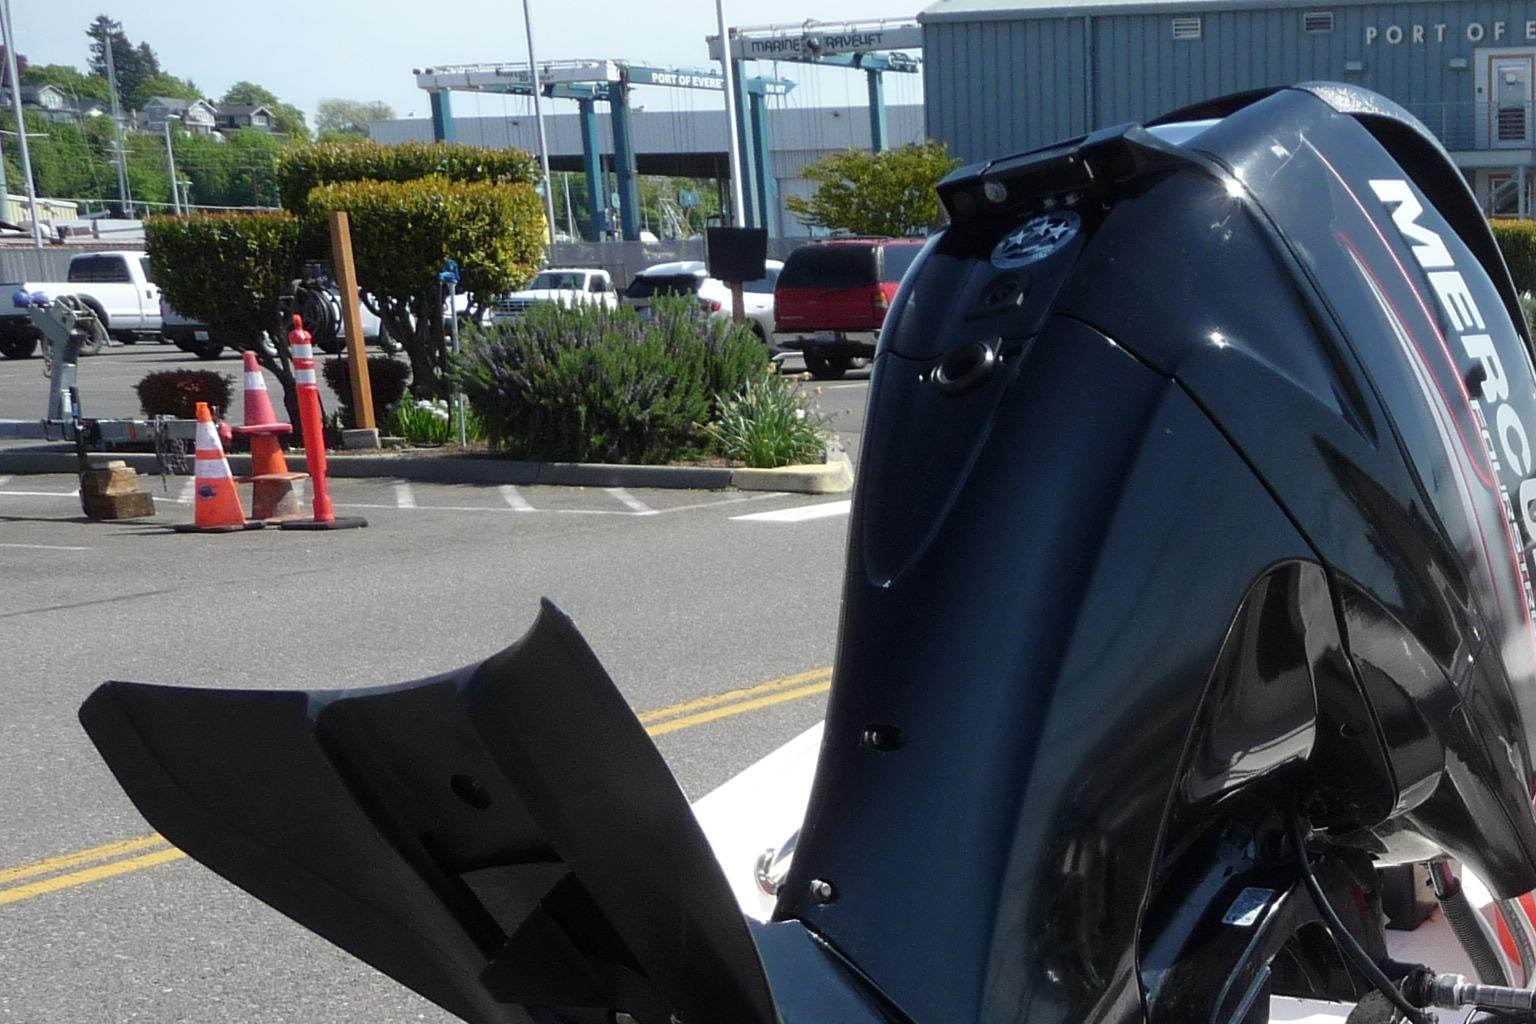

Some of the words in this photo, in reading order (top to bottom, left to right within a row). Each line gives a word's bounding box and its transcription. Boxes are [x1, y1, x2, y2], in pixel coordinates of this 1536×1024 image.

[751, 38, 801, 52] MARINE
[825, 32, 883, 49] RAVELIFT
[1365, 24, 1447, 45] PORT
[1466, 21, 1505, 42] OF
[651, 72, 677, 85] PORT
[680, 75, 691, 87] OF
